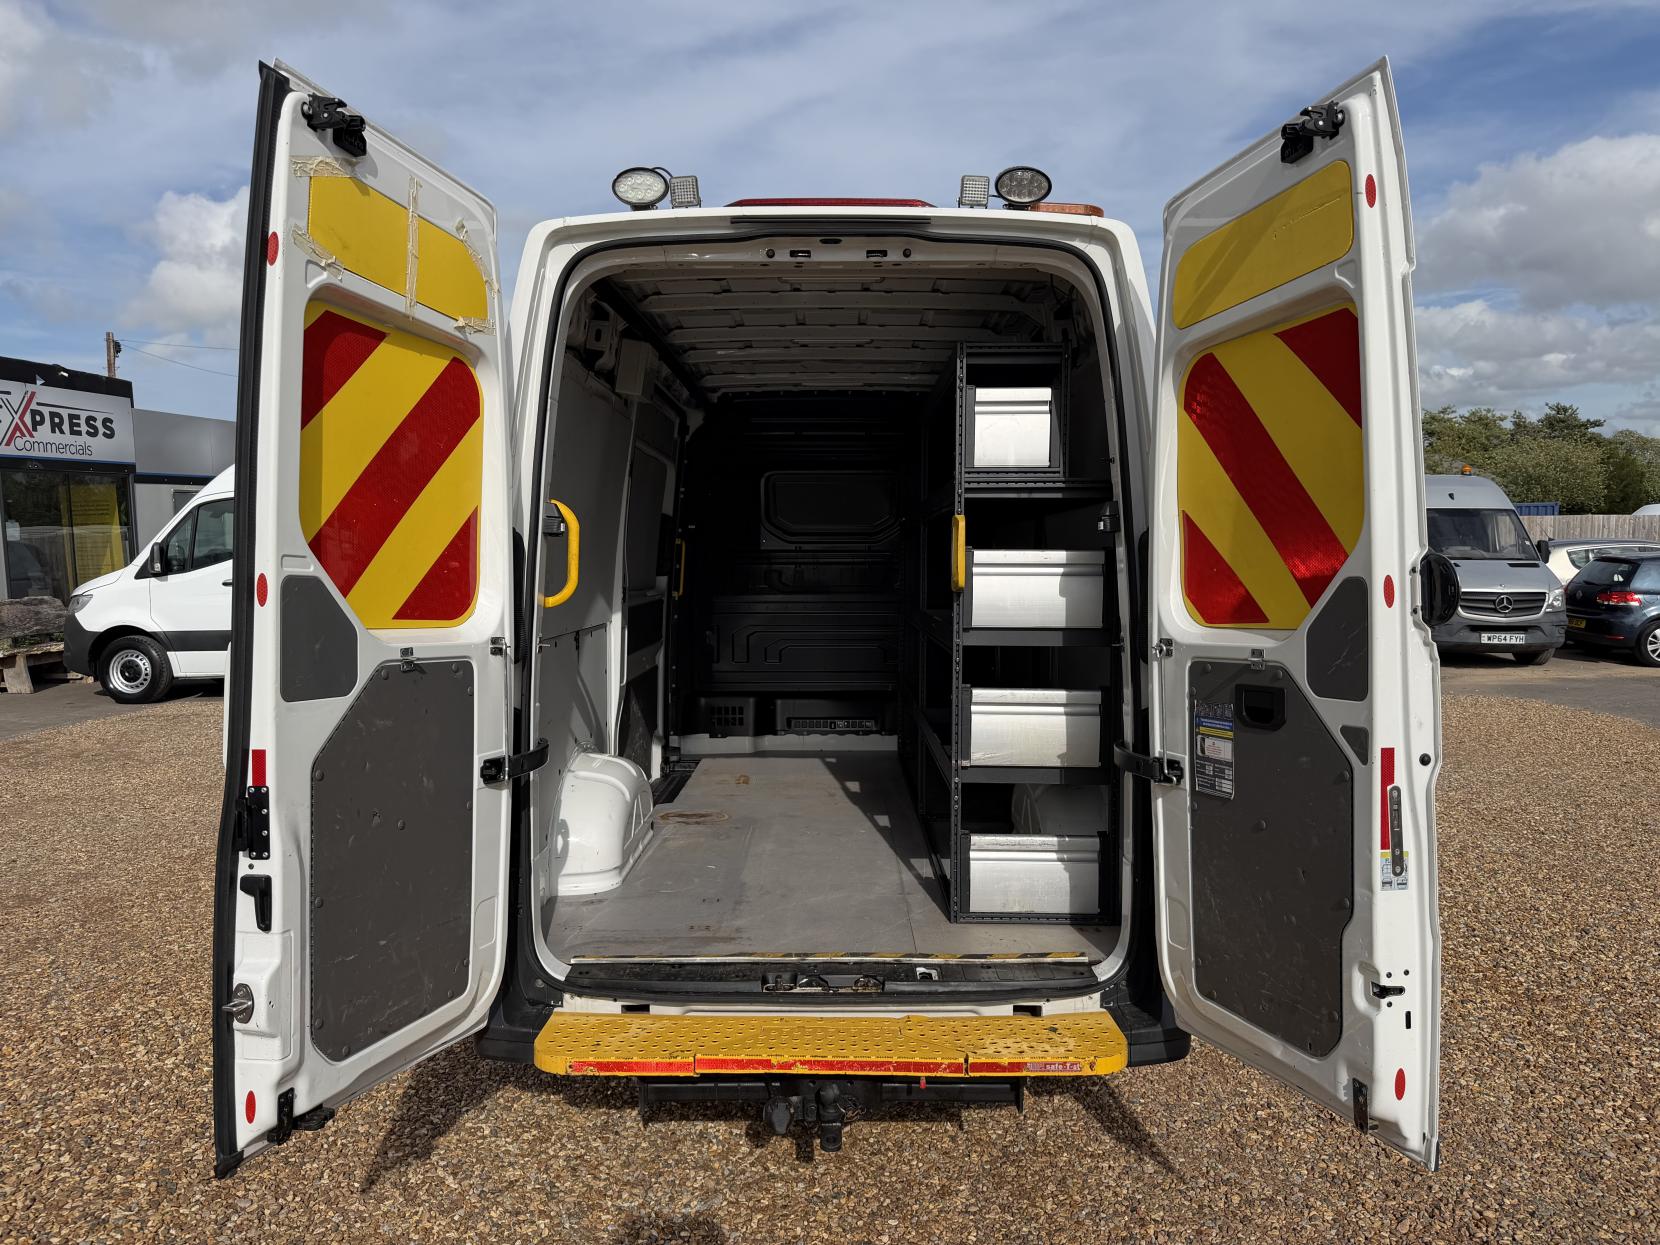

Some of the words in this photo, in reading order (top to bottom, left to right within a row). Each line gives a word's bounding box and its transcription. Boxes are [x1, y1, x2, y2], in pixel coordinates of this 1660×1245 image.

[0, 391, 116, 447] XPRESS
[14, 436, 93, 456] Commercials
[1486, 634, 1507, 643] WP64
[1509, 634, 1524, 643] FYH
